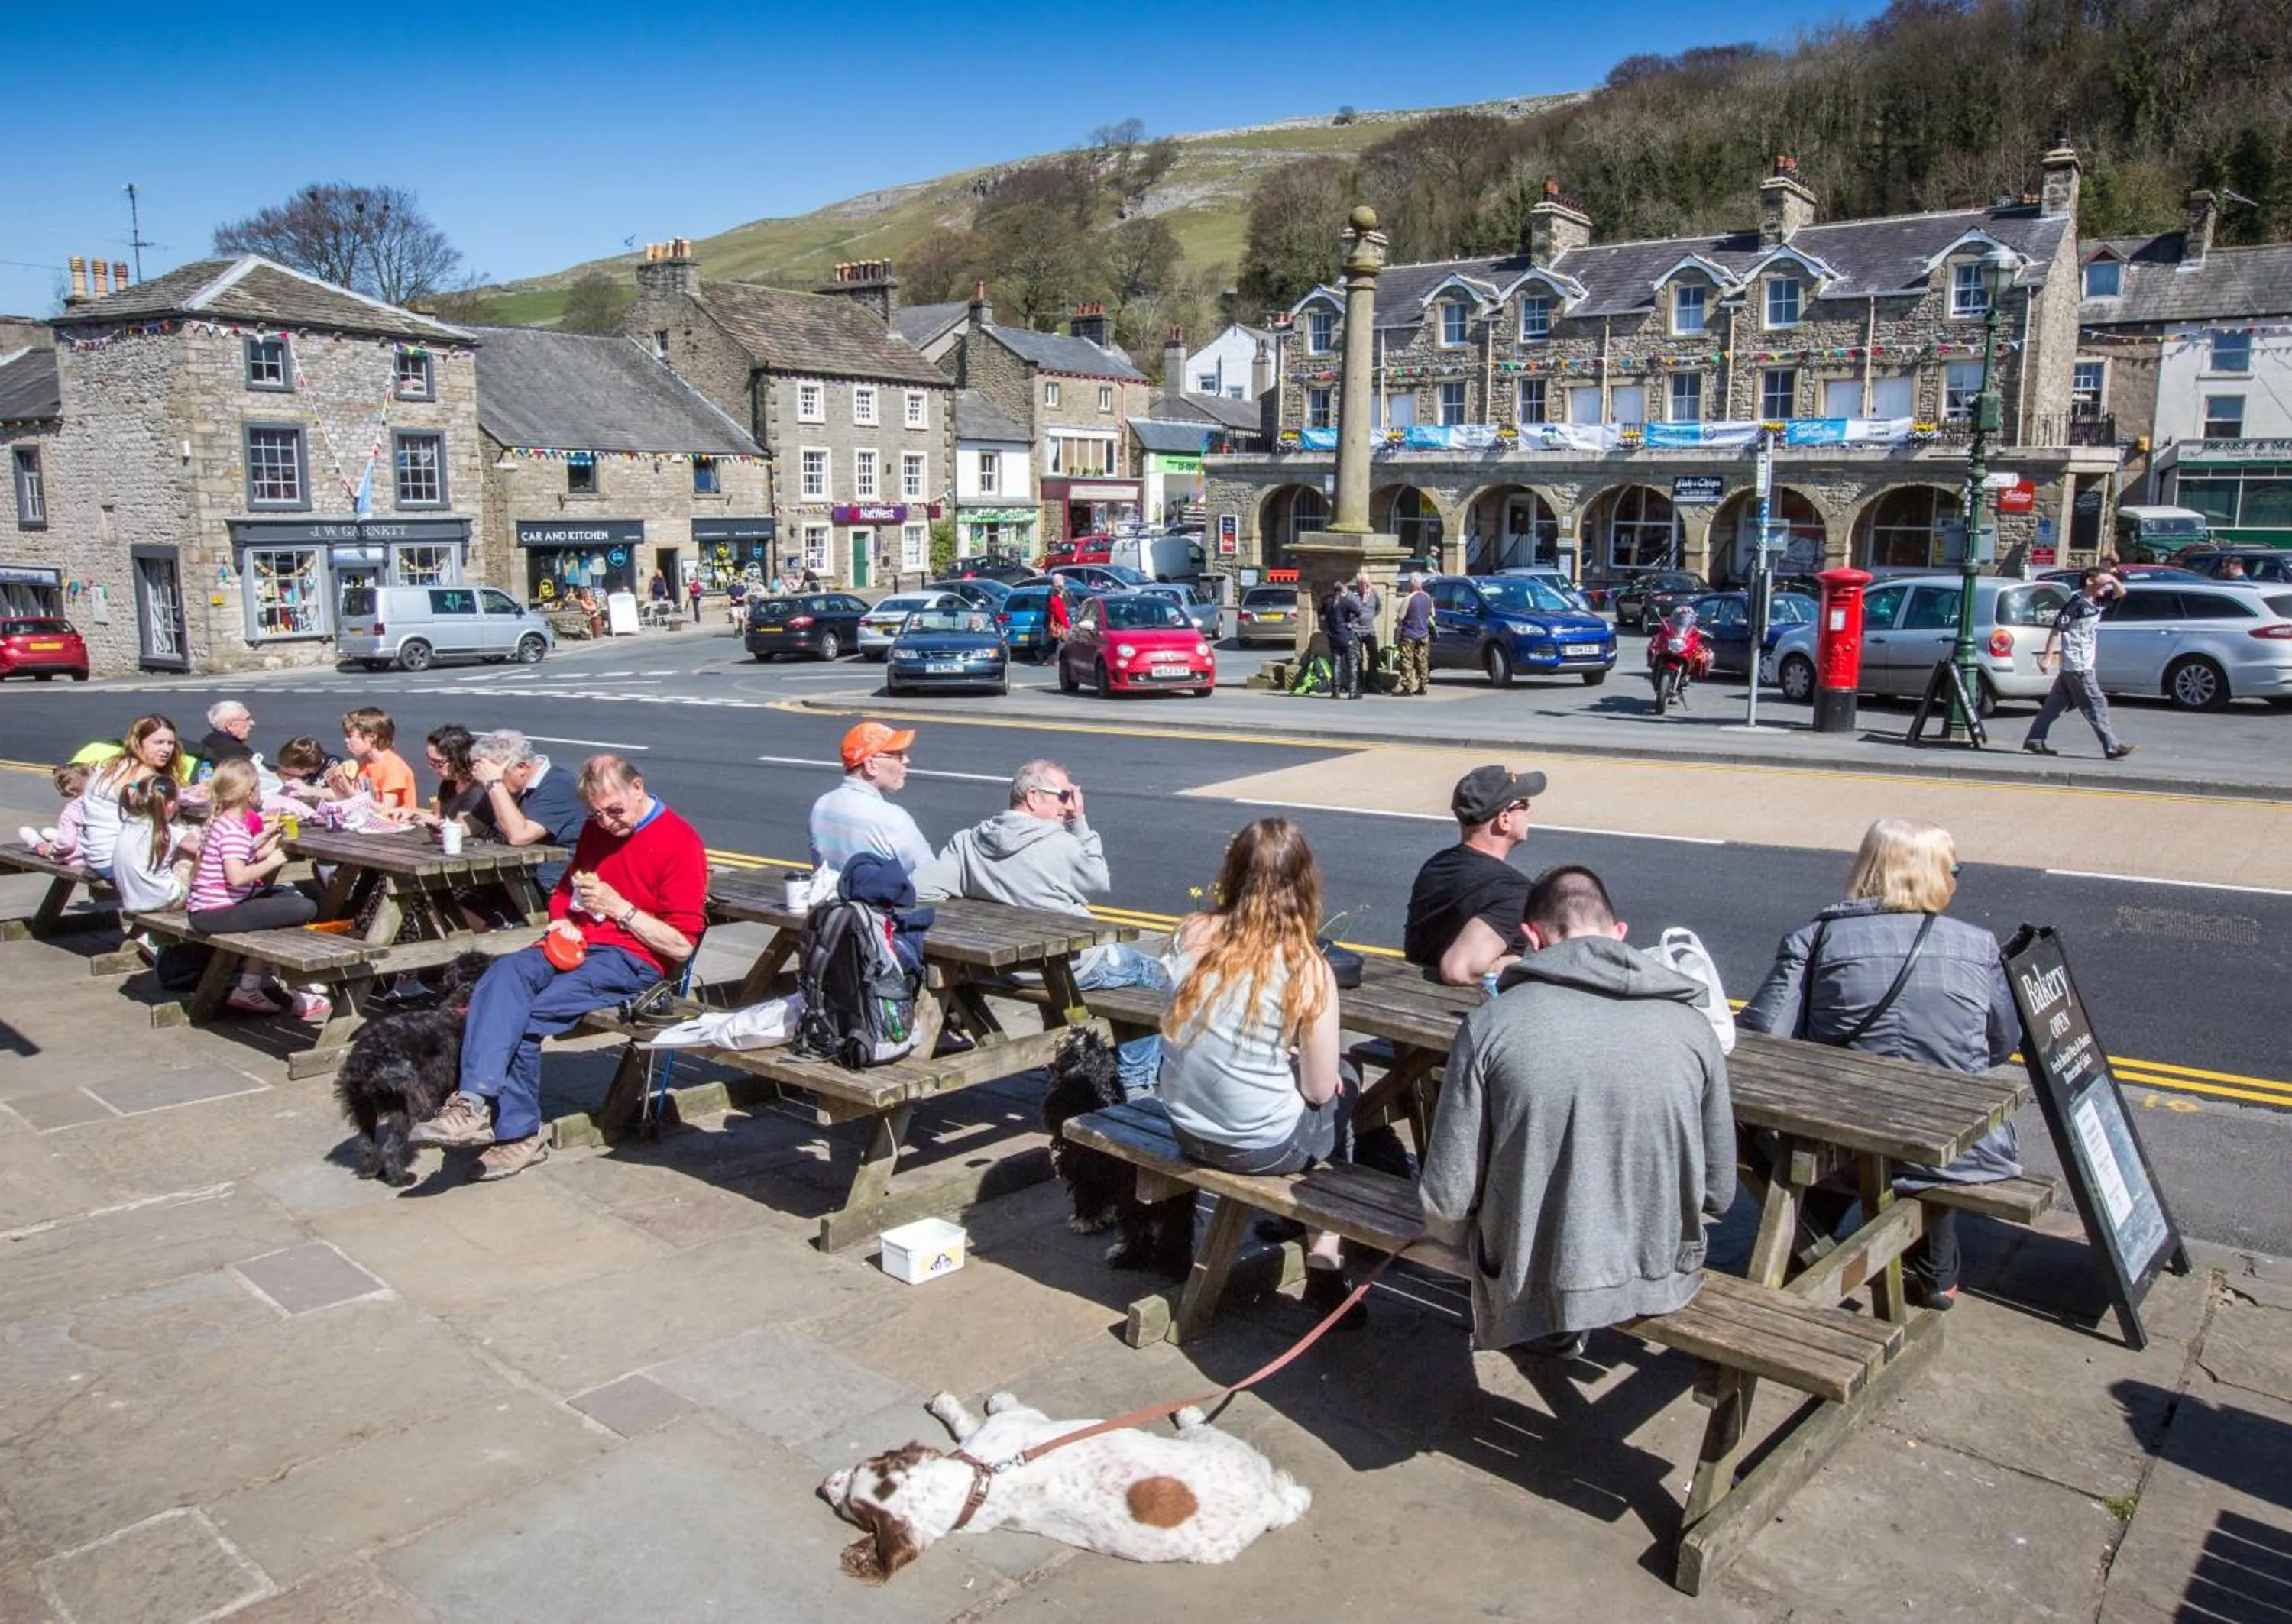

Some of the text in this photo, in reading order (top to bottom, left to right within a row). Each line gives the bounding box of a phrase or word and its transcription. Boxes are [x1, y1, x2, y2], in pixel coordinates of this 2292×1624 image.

[2201, 439, 2251, 452] DRAKE
[860, 507, 895, 519] NatWest
[341, 524, 407, 537] GARNETT
[521, 529, 609, 542] CAR AND KITCHEN
[2021, 962, 2072, 1015] Bakery
[2049, 1008, 2071, 1039] OPEN
